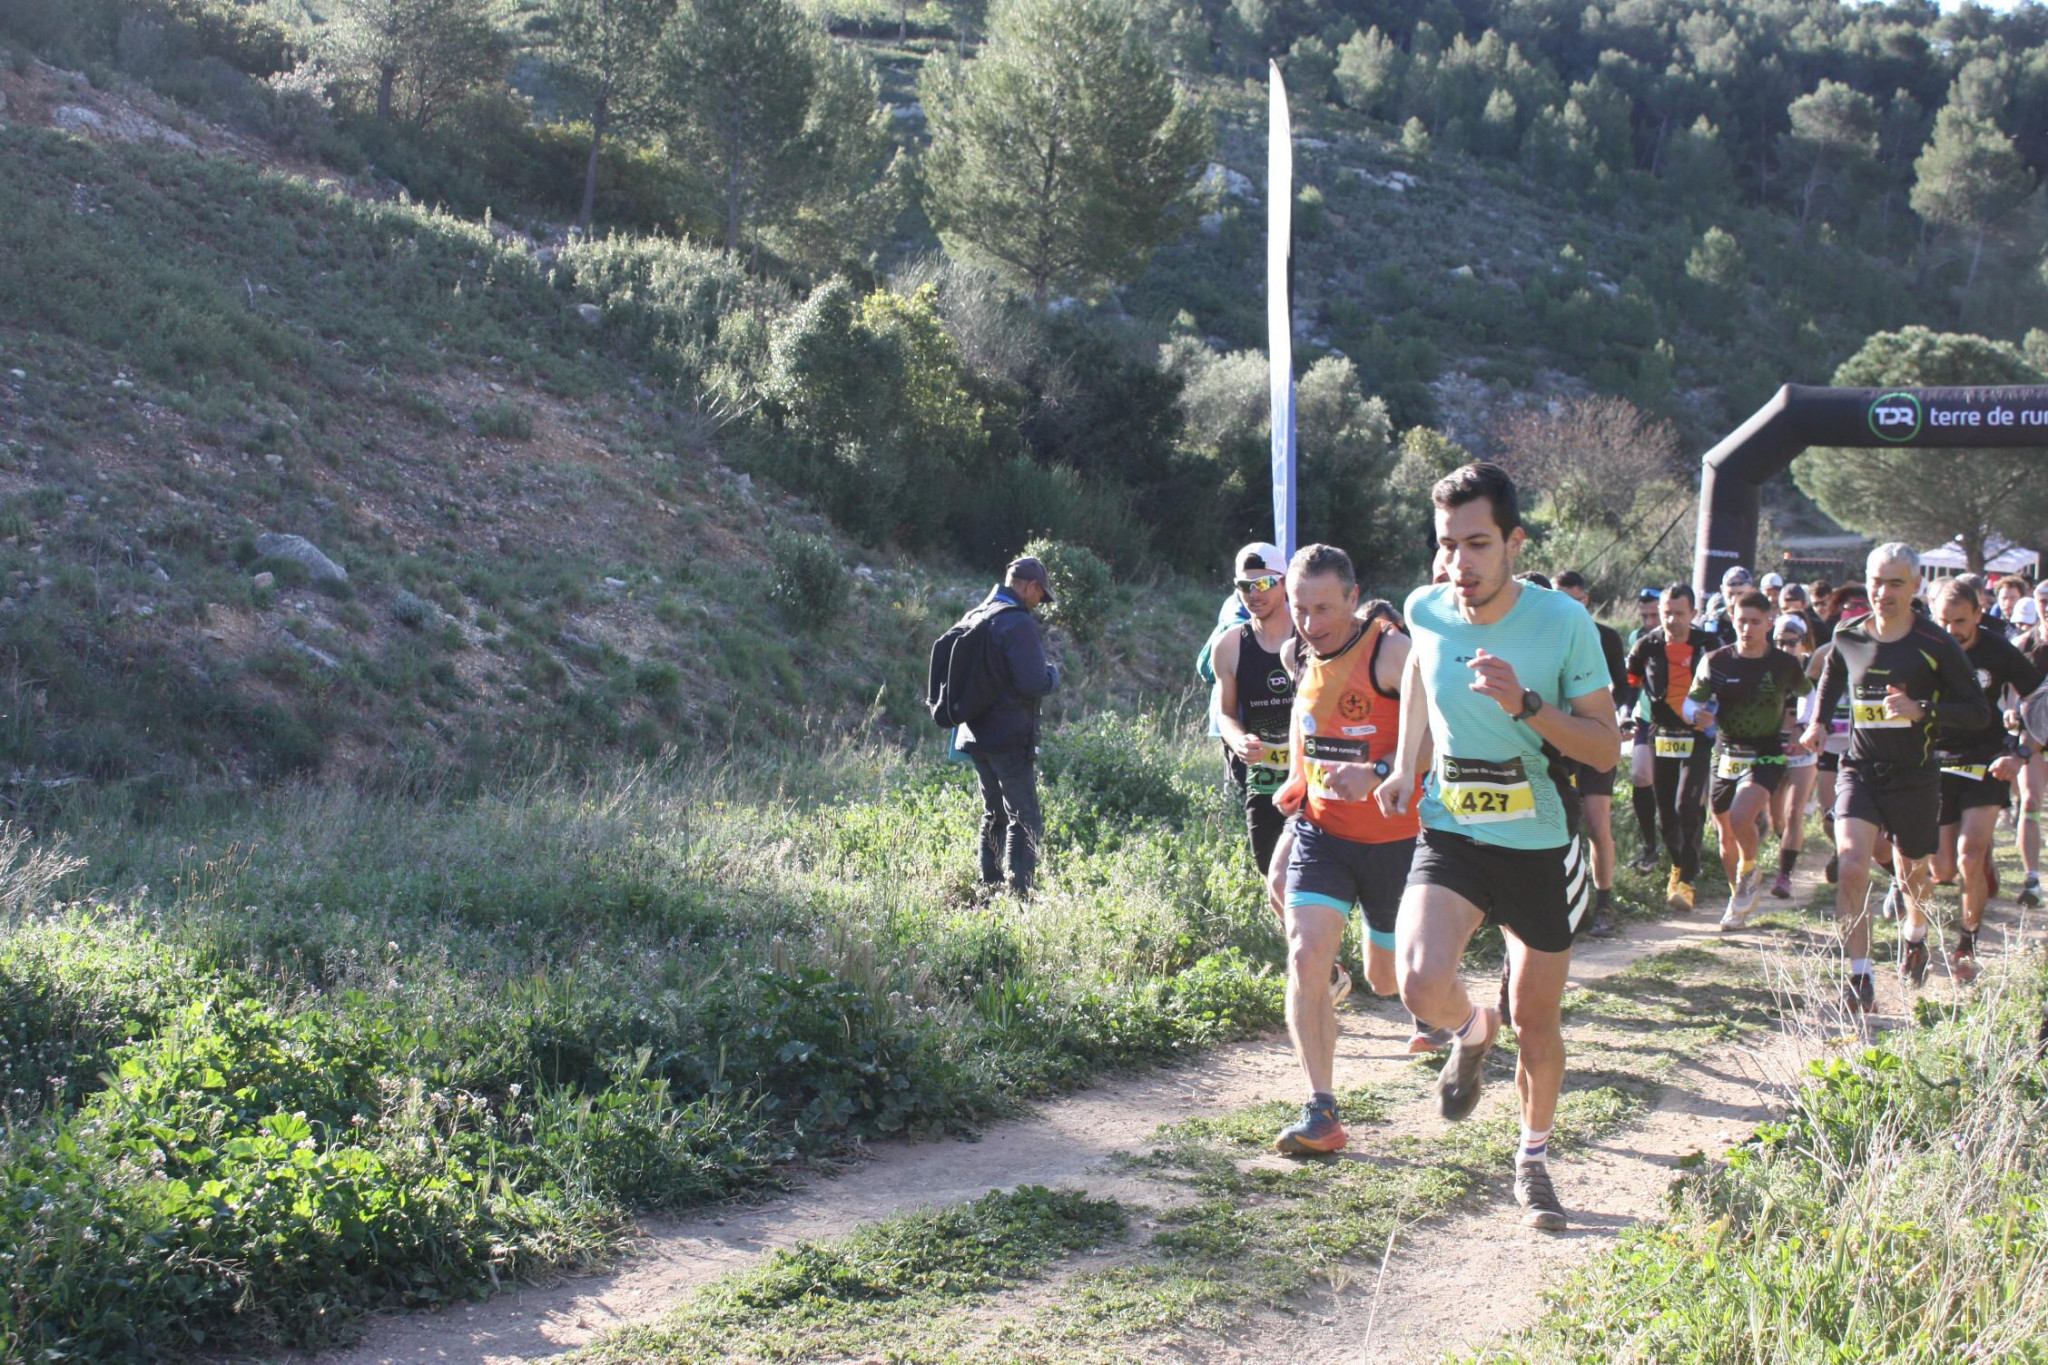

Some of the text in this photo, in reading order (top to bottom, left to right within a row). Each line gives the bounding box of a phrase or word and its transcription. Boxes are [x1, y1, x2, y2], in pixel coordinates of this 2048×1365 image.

[1874, 407, 1915, 426] TDR
[1930, 407, 1981, 426] terre
[1987, 406, 2014, 426] de
[1250, 698, 1269, 708] terre
[1270, 697, 1281, 706] de
[1665, 741, 1687, 753] 304
[1461, 791, 1510, 812] 427
